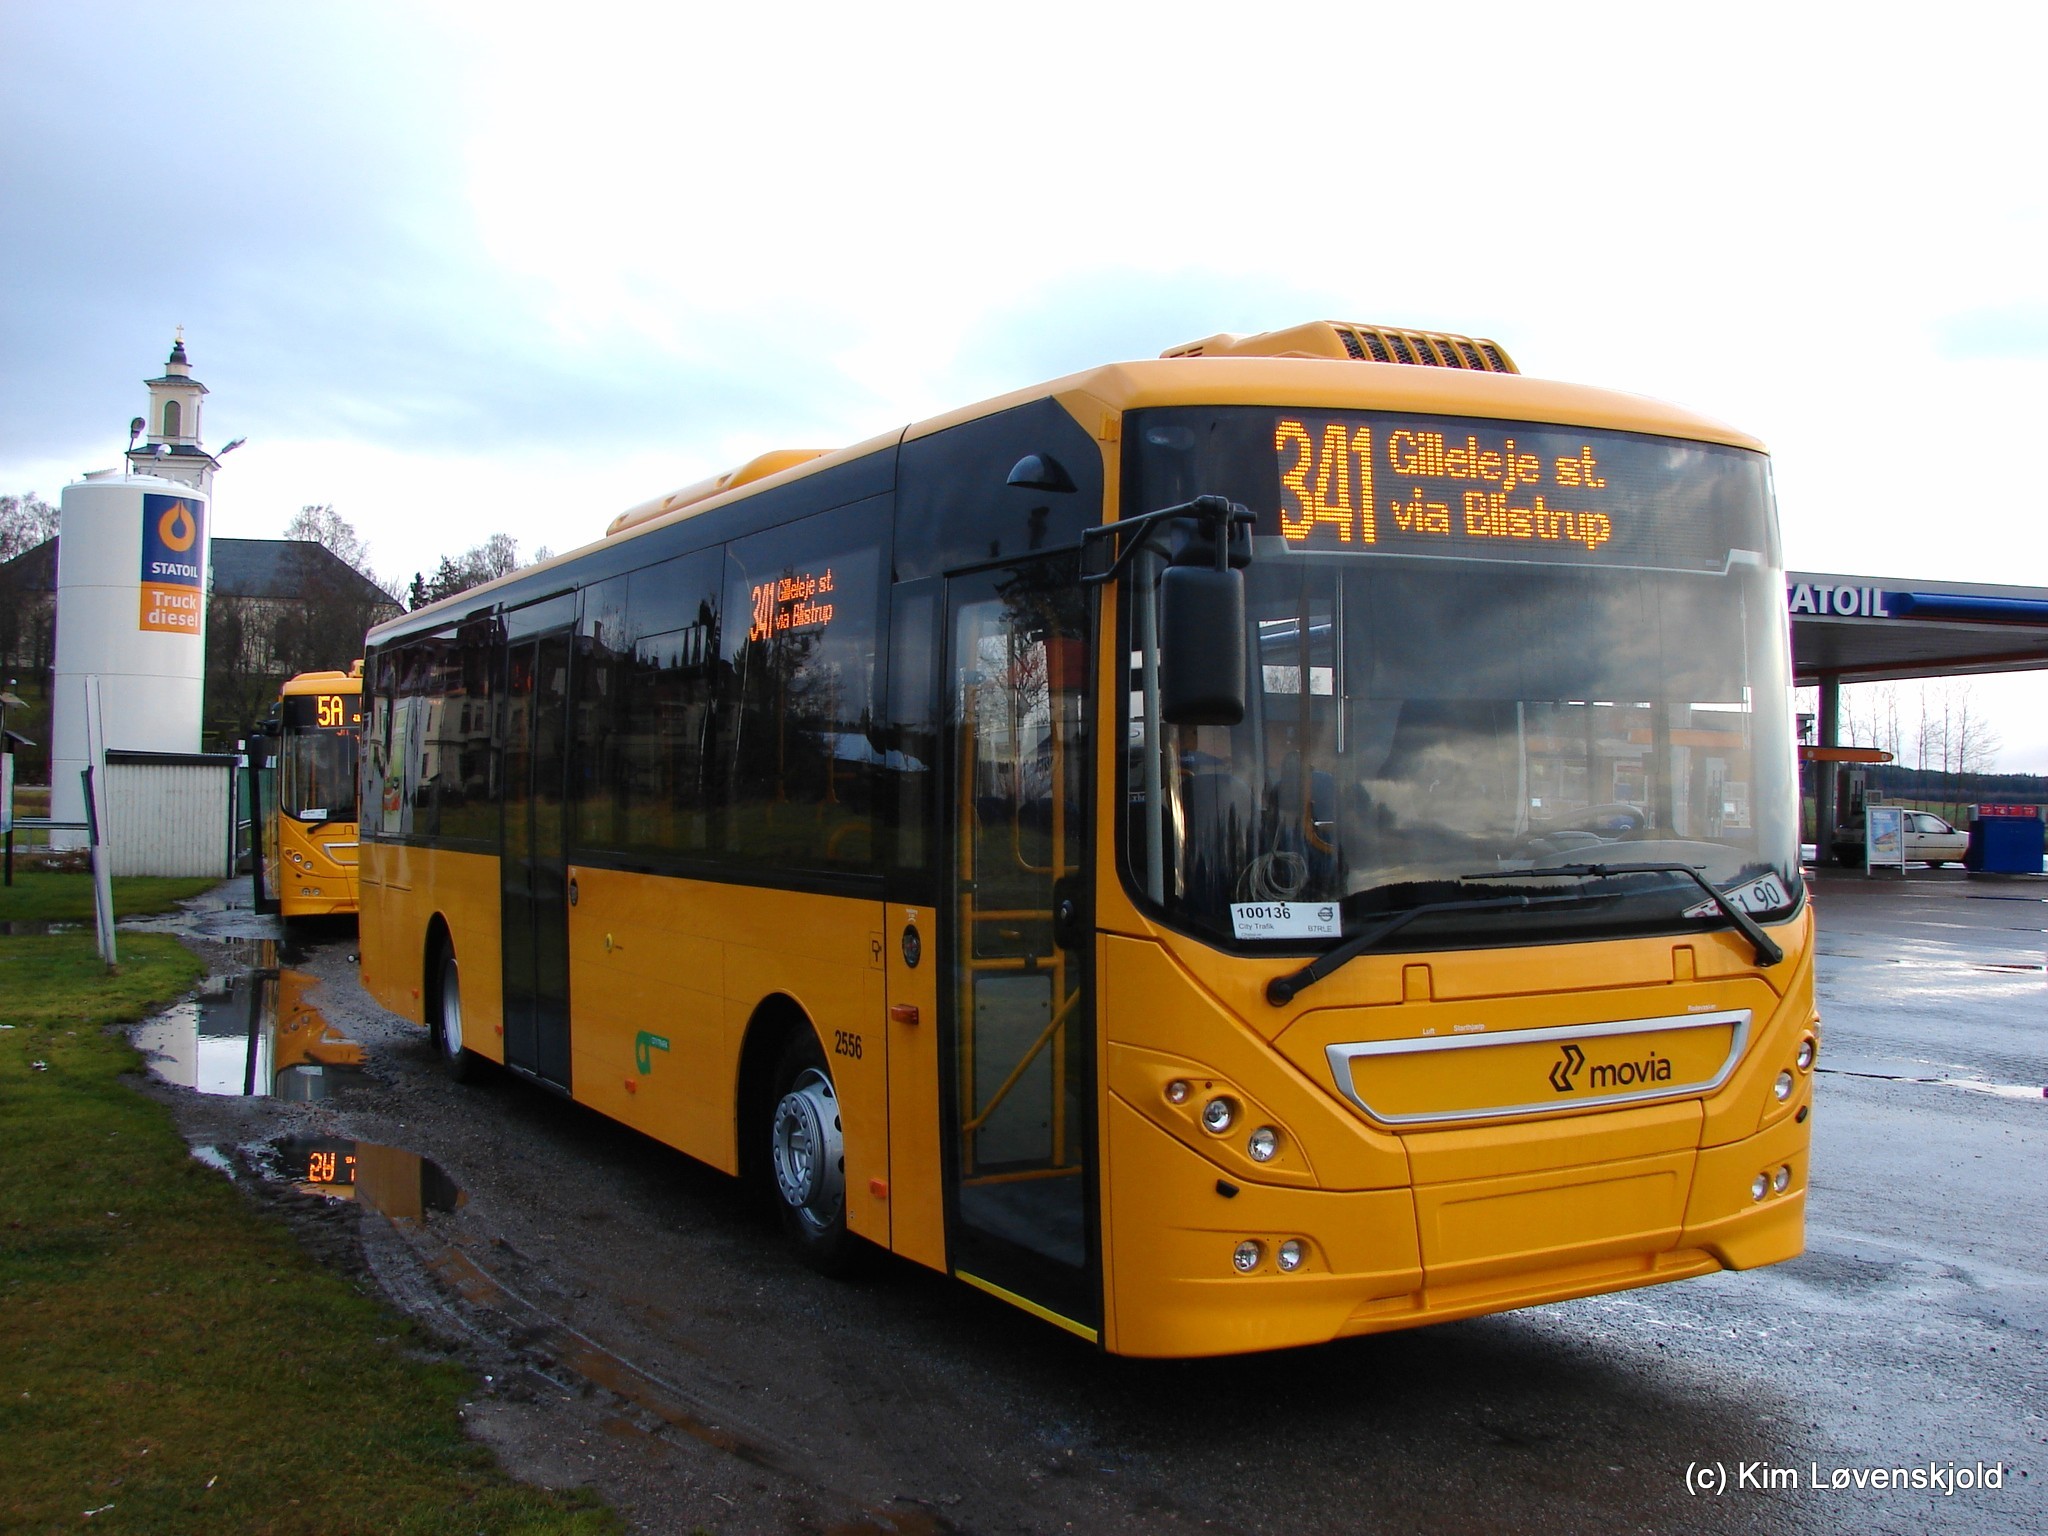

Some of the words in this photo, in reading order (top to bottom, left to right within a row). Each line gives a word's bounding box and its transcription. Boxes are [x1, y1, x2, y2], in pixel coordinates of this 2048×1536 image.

[1389, 429, 1541, 491] Gilleleje
[1555, 445, 1606, 489] st.
[1275, 420, 1376, 544] 341
[1391, 487, 1450, 533] via
[1464, 491, 1612, 551] Blistrup
[151, 561, 199, 578] STATOIL
[152, 591, 197, 609] Truck
[749, 582, 775, 642] 341
[1787, 583, 1889, 617] ATOIL
[148, 608, 198, 627] diesel
[317, 695, 344, 726] 5A
[1237, 906, 1291, 919] 100136
[834, 1029, 863, 1060] 2556
[1589, 1050, 1672, 1089] movia
